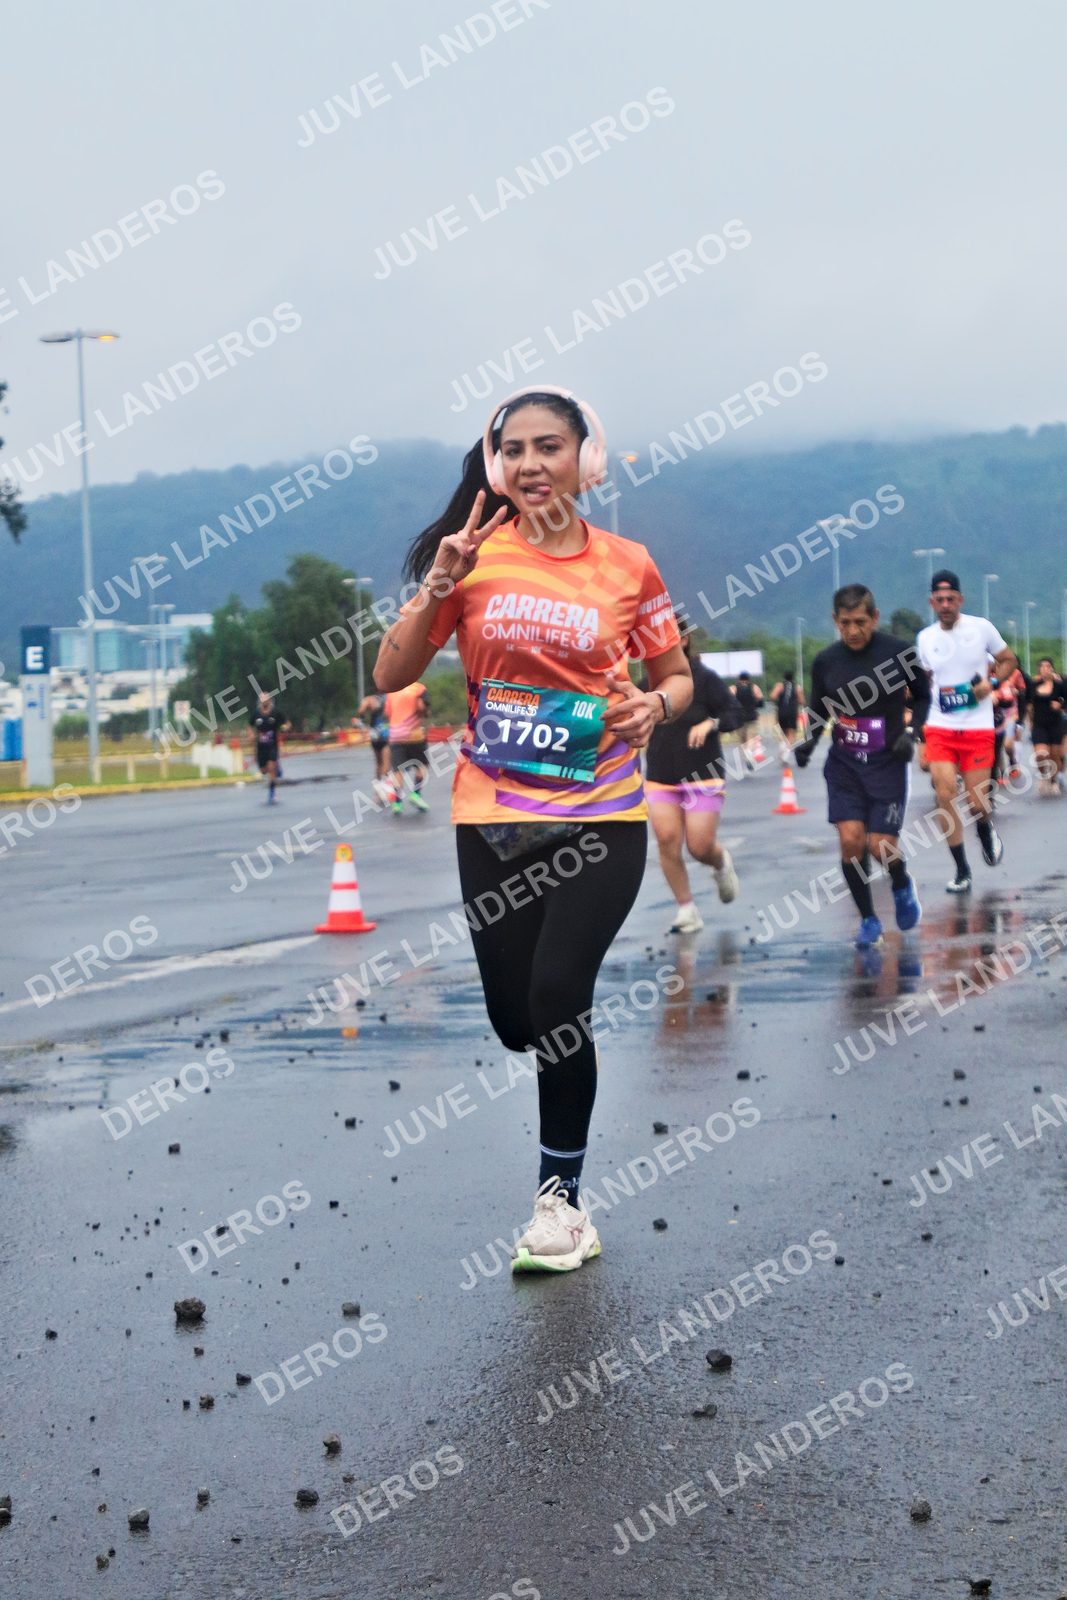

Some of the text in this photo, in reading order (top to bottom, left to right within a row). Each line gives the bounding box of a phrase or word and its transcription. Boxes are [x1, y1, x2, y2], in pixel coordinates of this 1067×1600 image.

[484, 593, 599, 633] CARRERA
[482, 623, 571, 647] OMNILIFE
[26, 646, 44, 671] E
[486, 688, 540, 706] CARRERA
[486, 701, 526, 715] OMNILIFE
[572, 701, 597, 720] 10K
[497, 718, 570, 752] 1702
[845, 730, 869, 745] 273
